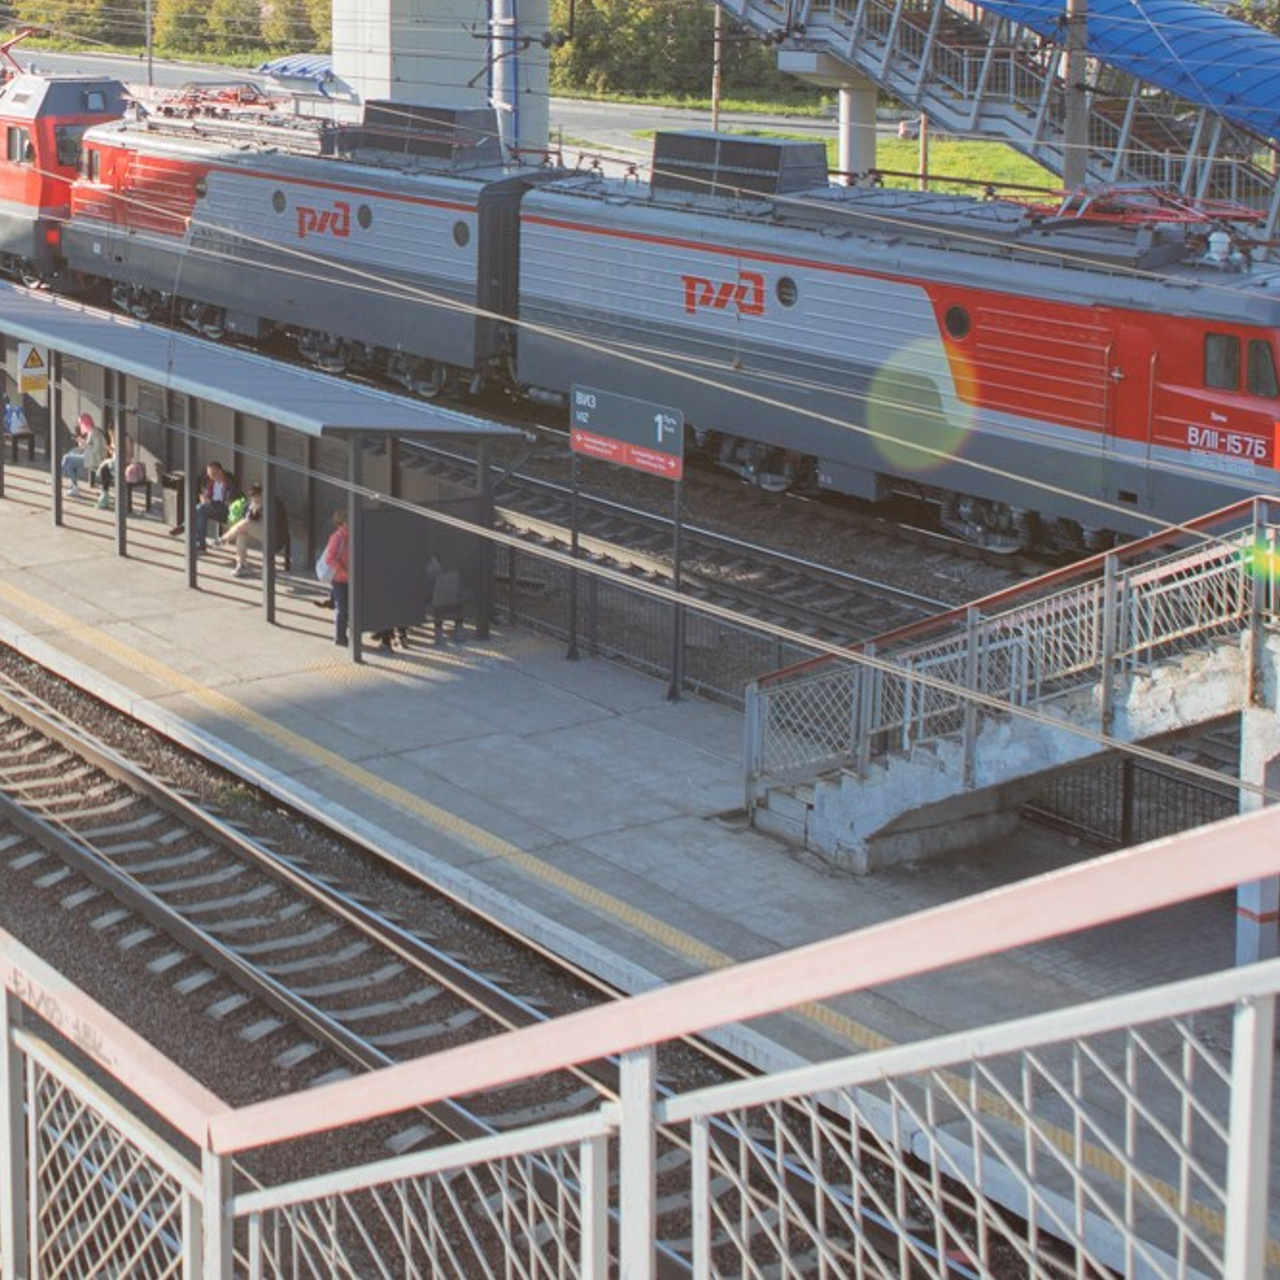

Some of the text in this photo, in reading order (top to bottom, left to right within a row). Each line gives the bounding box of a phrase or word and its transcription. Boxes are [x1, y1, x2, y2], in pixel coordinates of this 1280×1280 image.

[680, 271, 765, 315] РЖД
[575, 391, 597, 409] ВИЗ
[654, 413, 664, 442] 1
